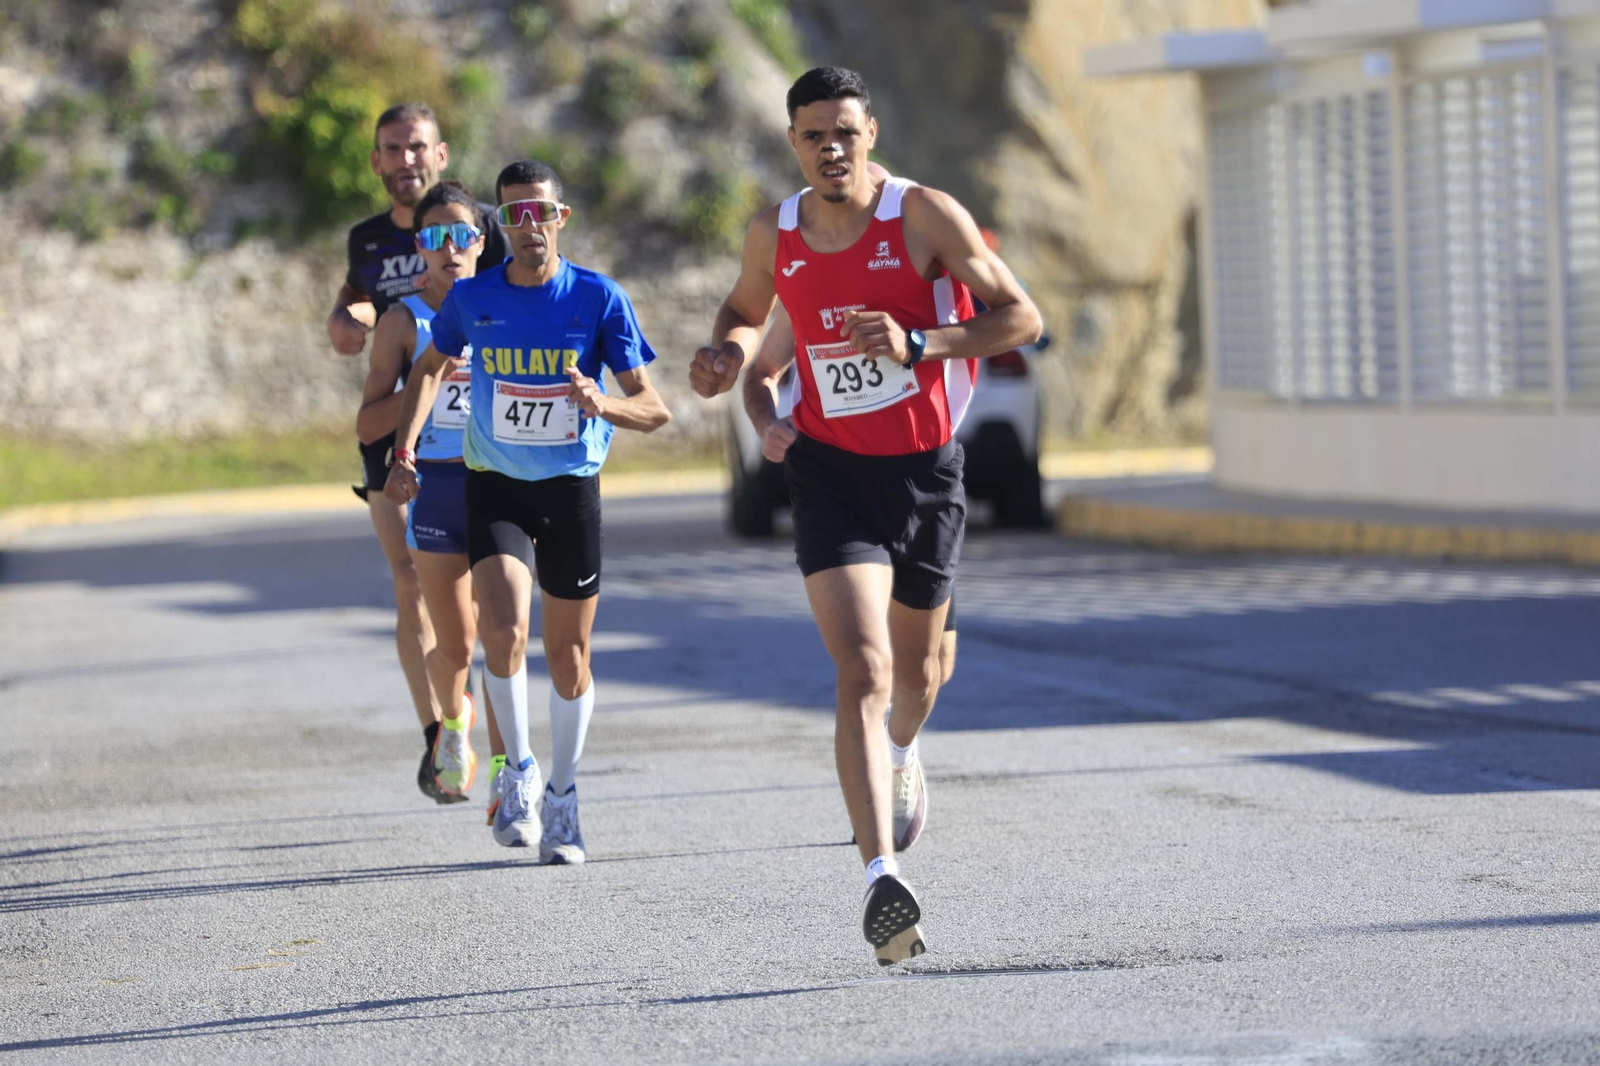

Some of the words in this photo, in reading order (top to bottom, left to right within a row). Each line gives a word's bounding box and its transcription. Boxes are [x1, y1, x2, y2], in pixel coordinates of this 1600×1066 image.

[867, 259, 900, 269] SAYMA
[826, 358, 884, 394] 293
[843, 393, 868, 401] MOHAMED
[504, 399, 554, 428] 477
